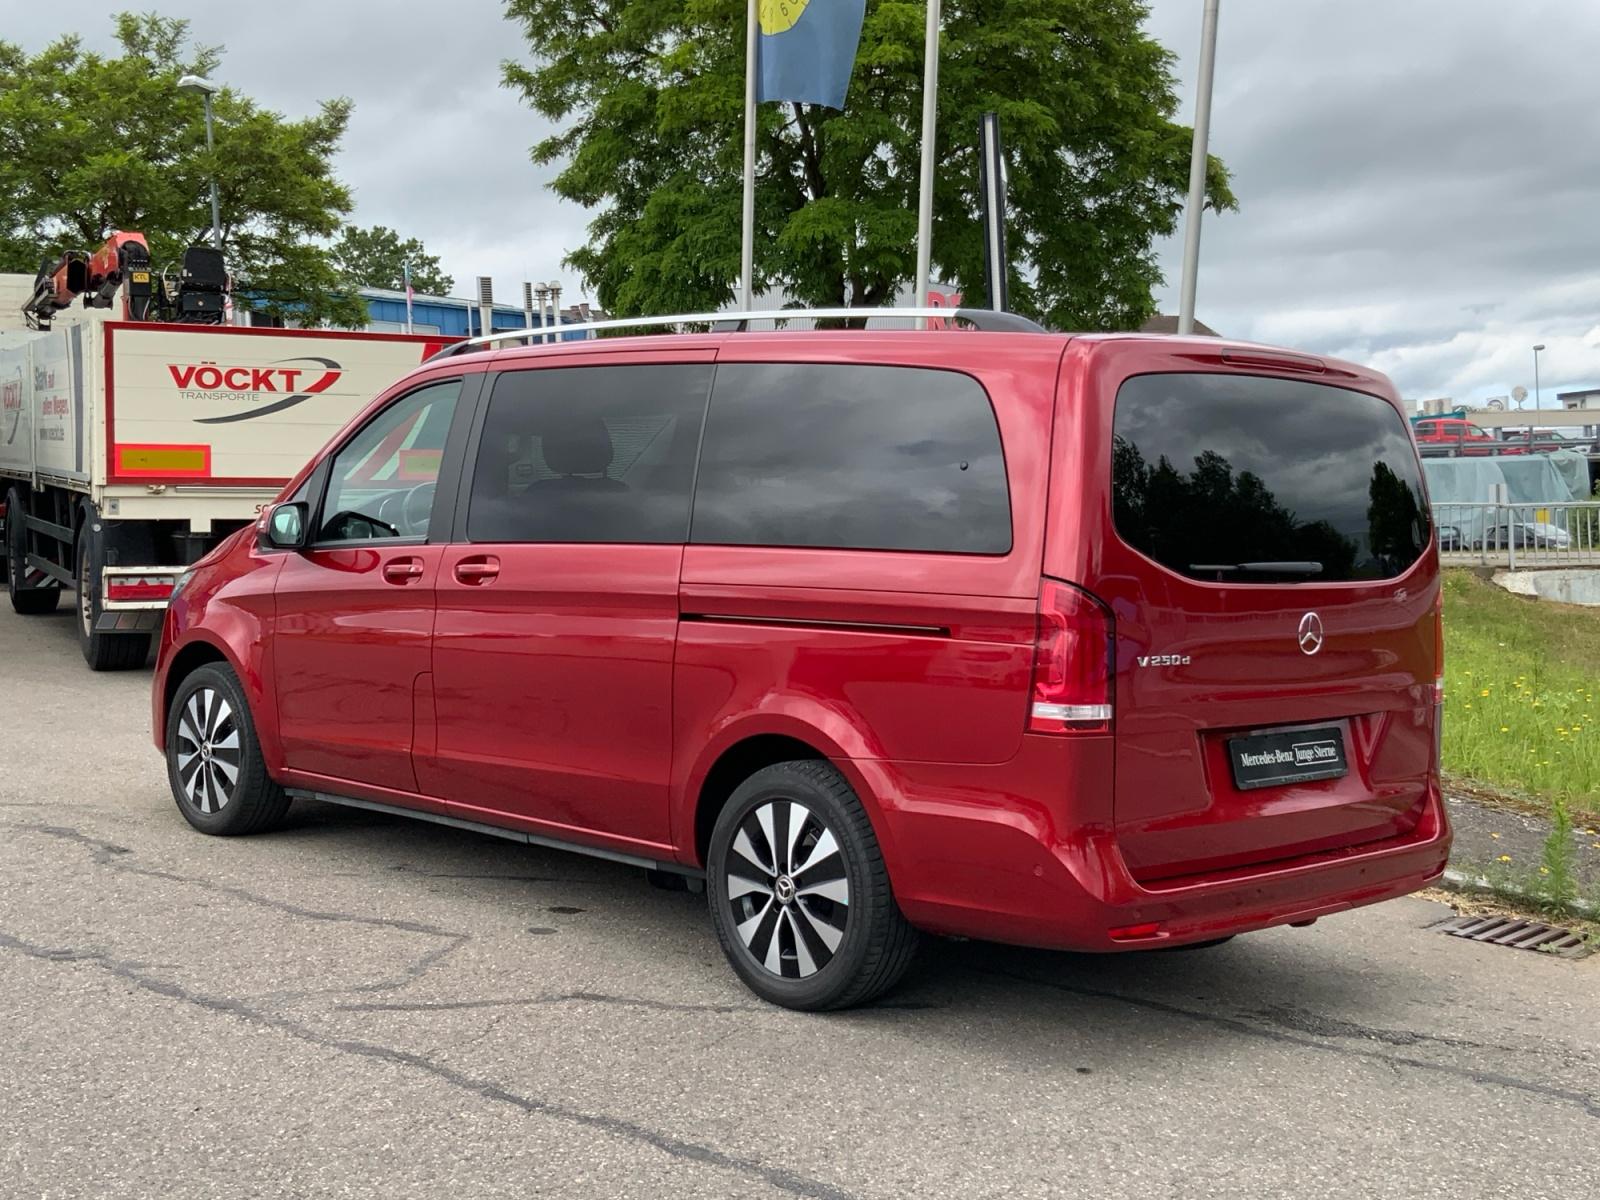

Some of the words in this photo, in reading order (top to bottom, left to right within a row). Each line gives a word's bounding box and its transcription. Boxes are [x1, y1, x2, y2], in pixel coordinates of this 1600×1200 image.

[168, 361, 302, 393] VÖCKT
[179, 391, 260, 402] TRANSPORTE
[1241, 749, 1294, 767] Mercedes-Benz
[1295, 747, 1315, 762] Junge
[1314, 745, 1336, 759] Sterne
